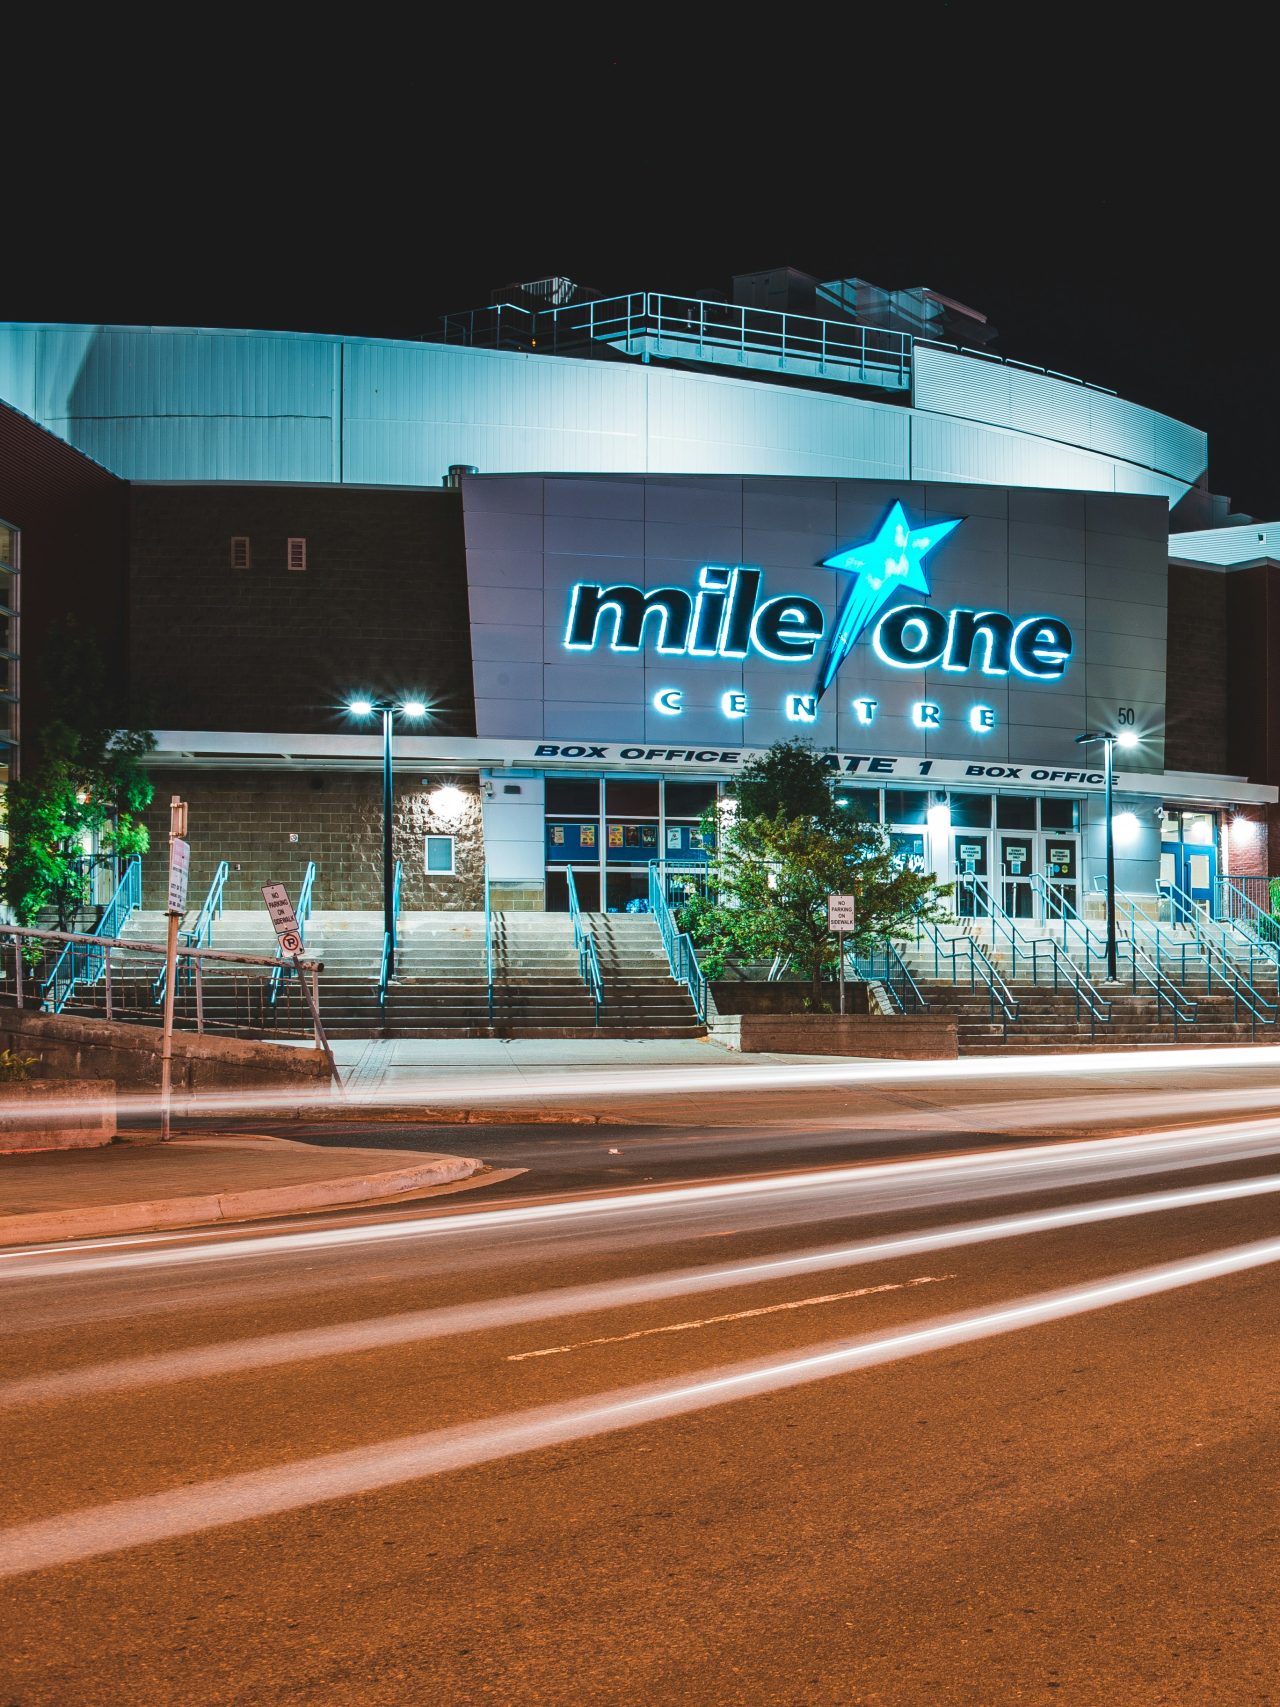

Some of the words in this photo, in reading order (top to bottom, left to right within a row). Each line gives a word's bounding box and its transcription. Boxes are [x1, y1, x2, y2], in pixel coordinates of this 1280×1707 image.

[564, 566, 825, 661] mile
[872, 603, 1073, 679] one
[655, 690, 995, 731] CENTRE
[1117, 707, 1135, 726] 50
[534, 744, 609, 759] BOX
[619, 747, 741, 764] OFFICE
[797, 753, 898, 774] ATE
[918, 760, 934, 776] 1
[965, 765, 1023, 779] BOX
[1030, 769, 1121, 786] OFFICE
[269, 899, 288, 908] PARKING
